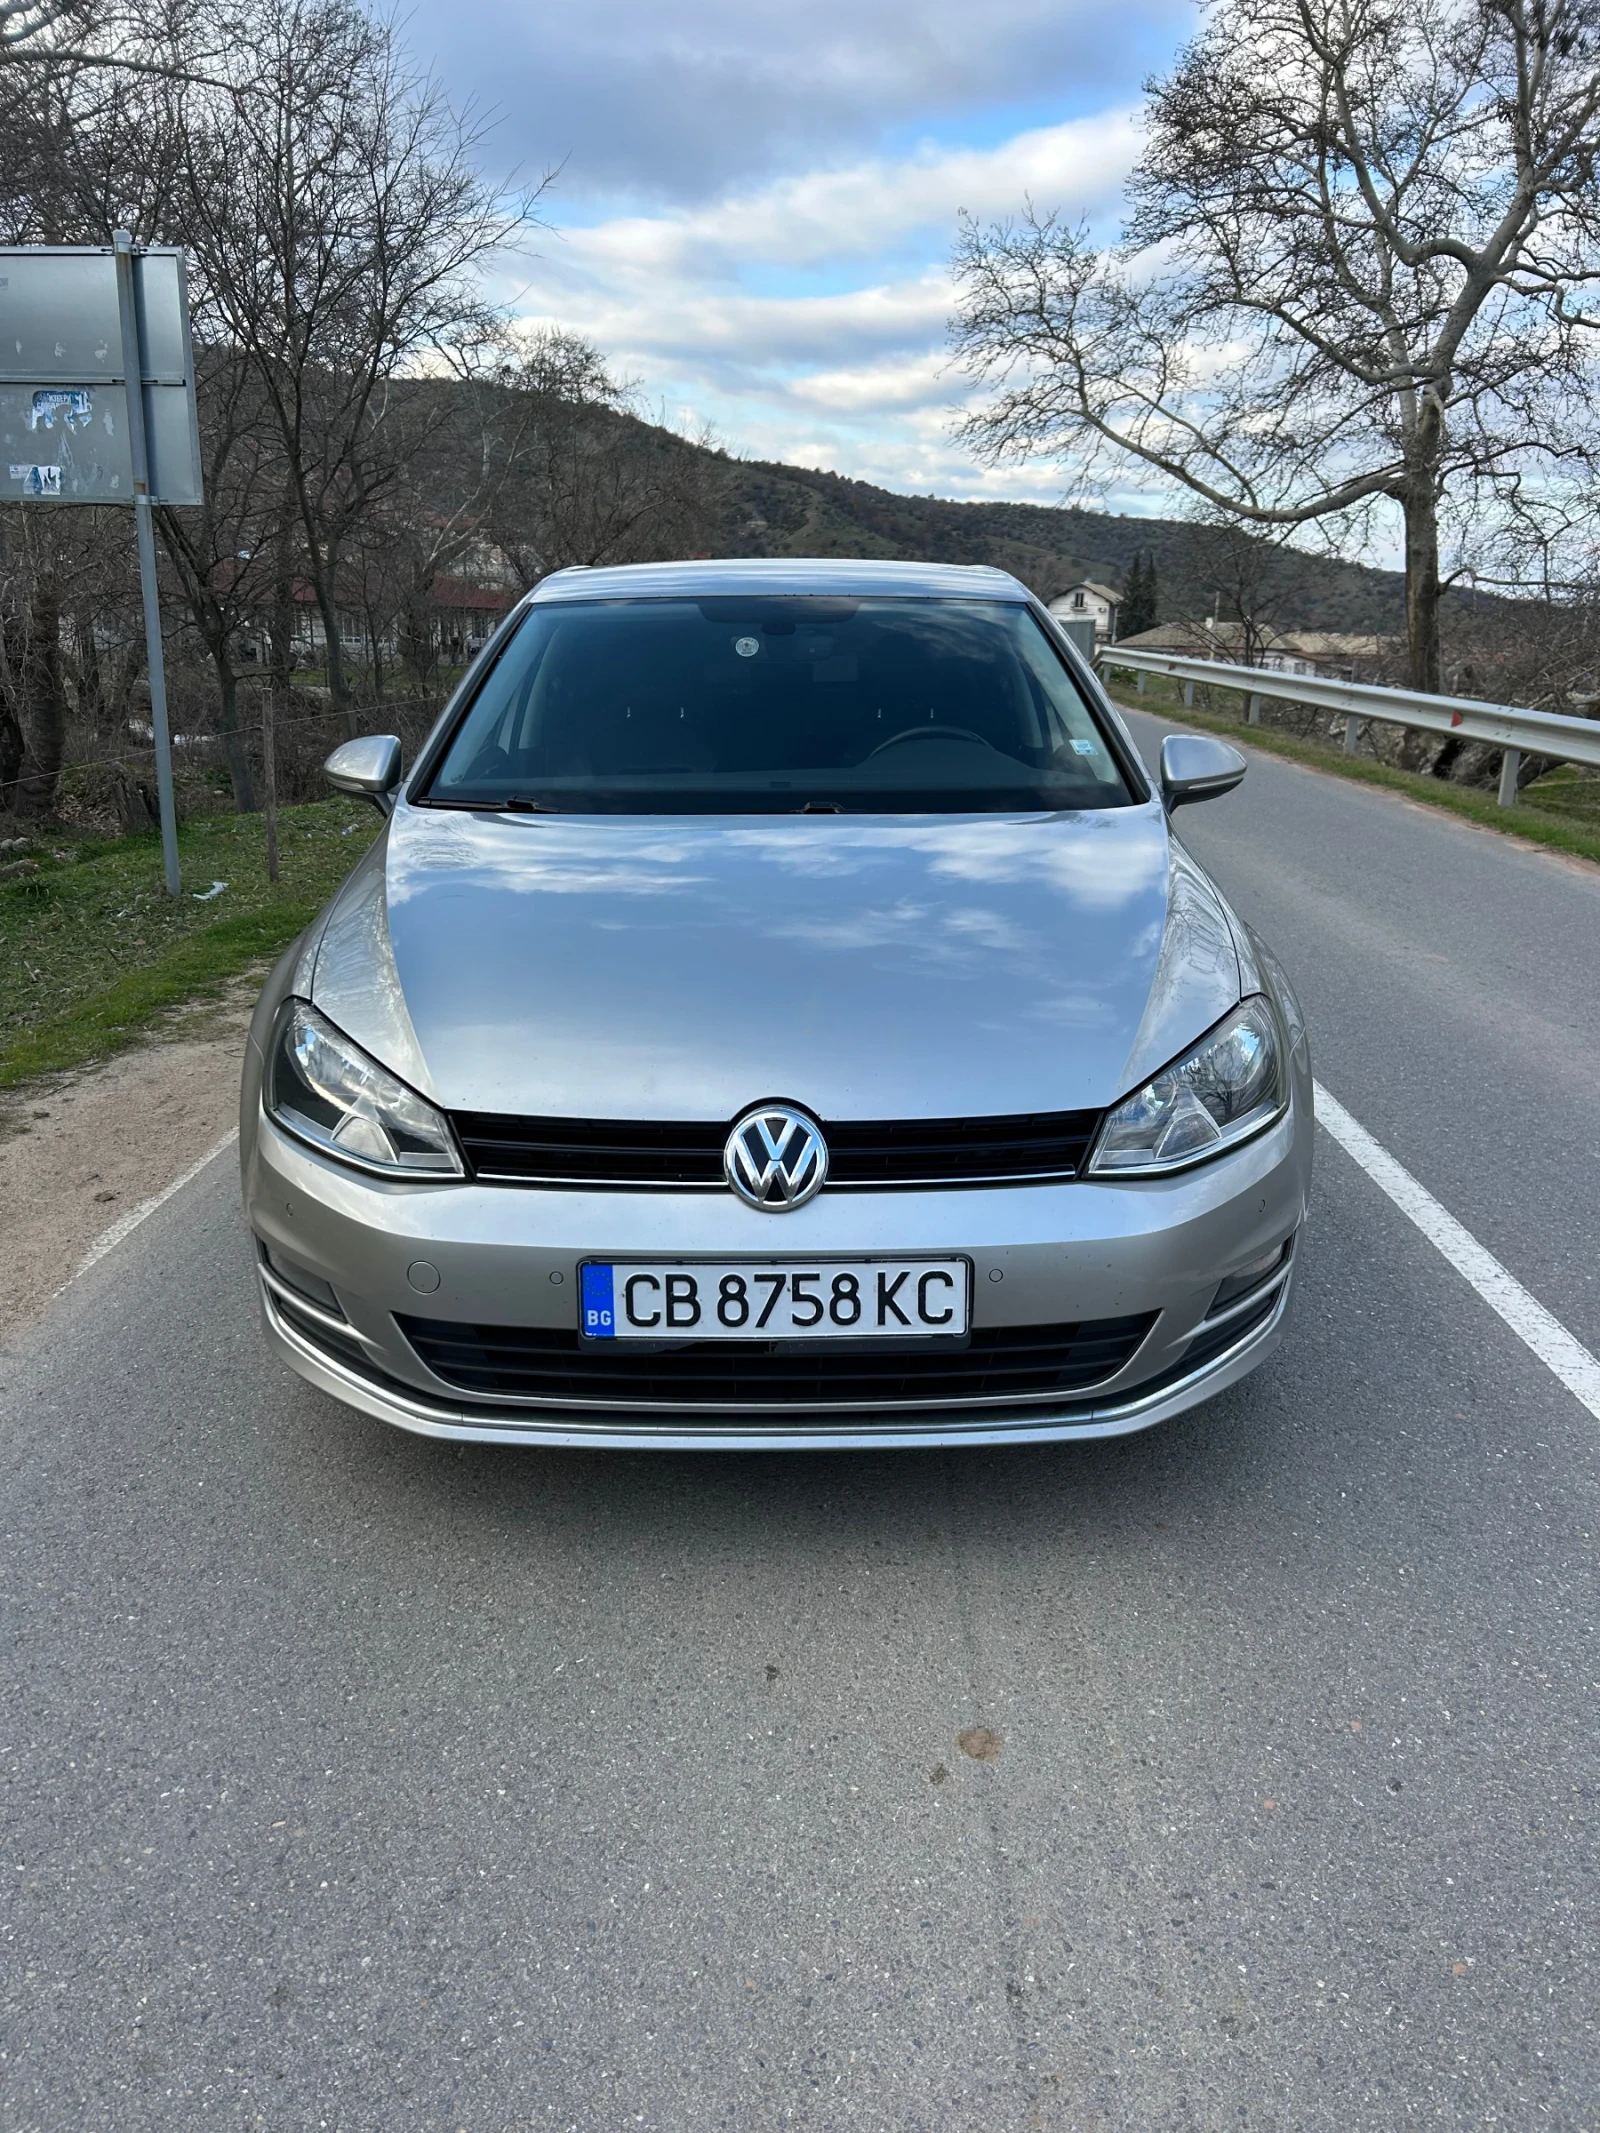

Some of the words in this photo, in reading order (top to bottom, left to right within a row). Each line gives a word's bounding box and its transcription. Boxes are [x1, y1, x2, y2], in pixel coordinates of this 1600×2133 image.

[728, 1110, 824, 1207] VW
[587, 1310, 612, 1326] BG
[624, 1273, 701, 1327] CB
[716, 1272, 861, 1328] 8758
[877, 1270, 954, 1326] KC
